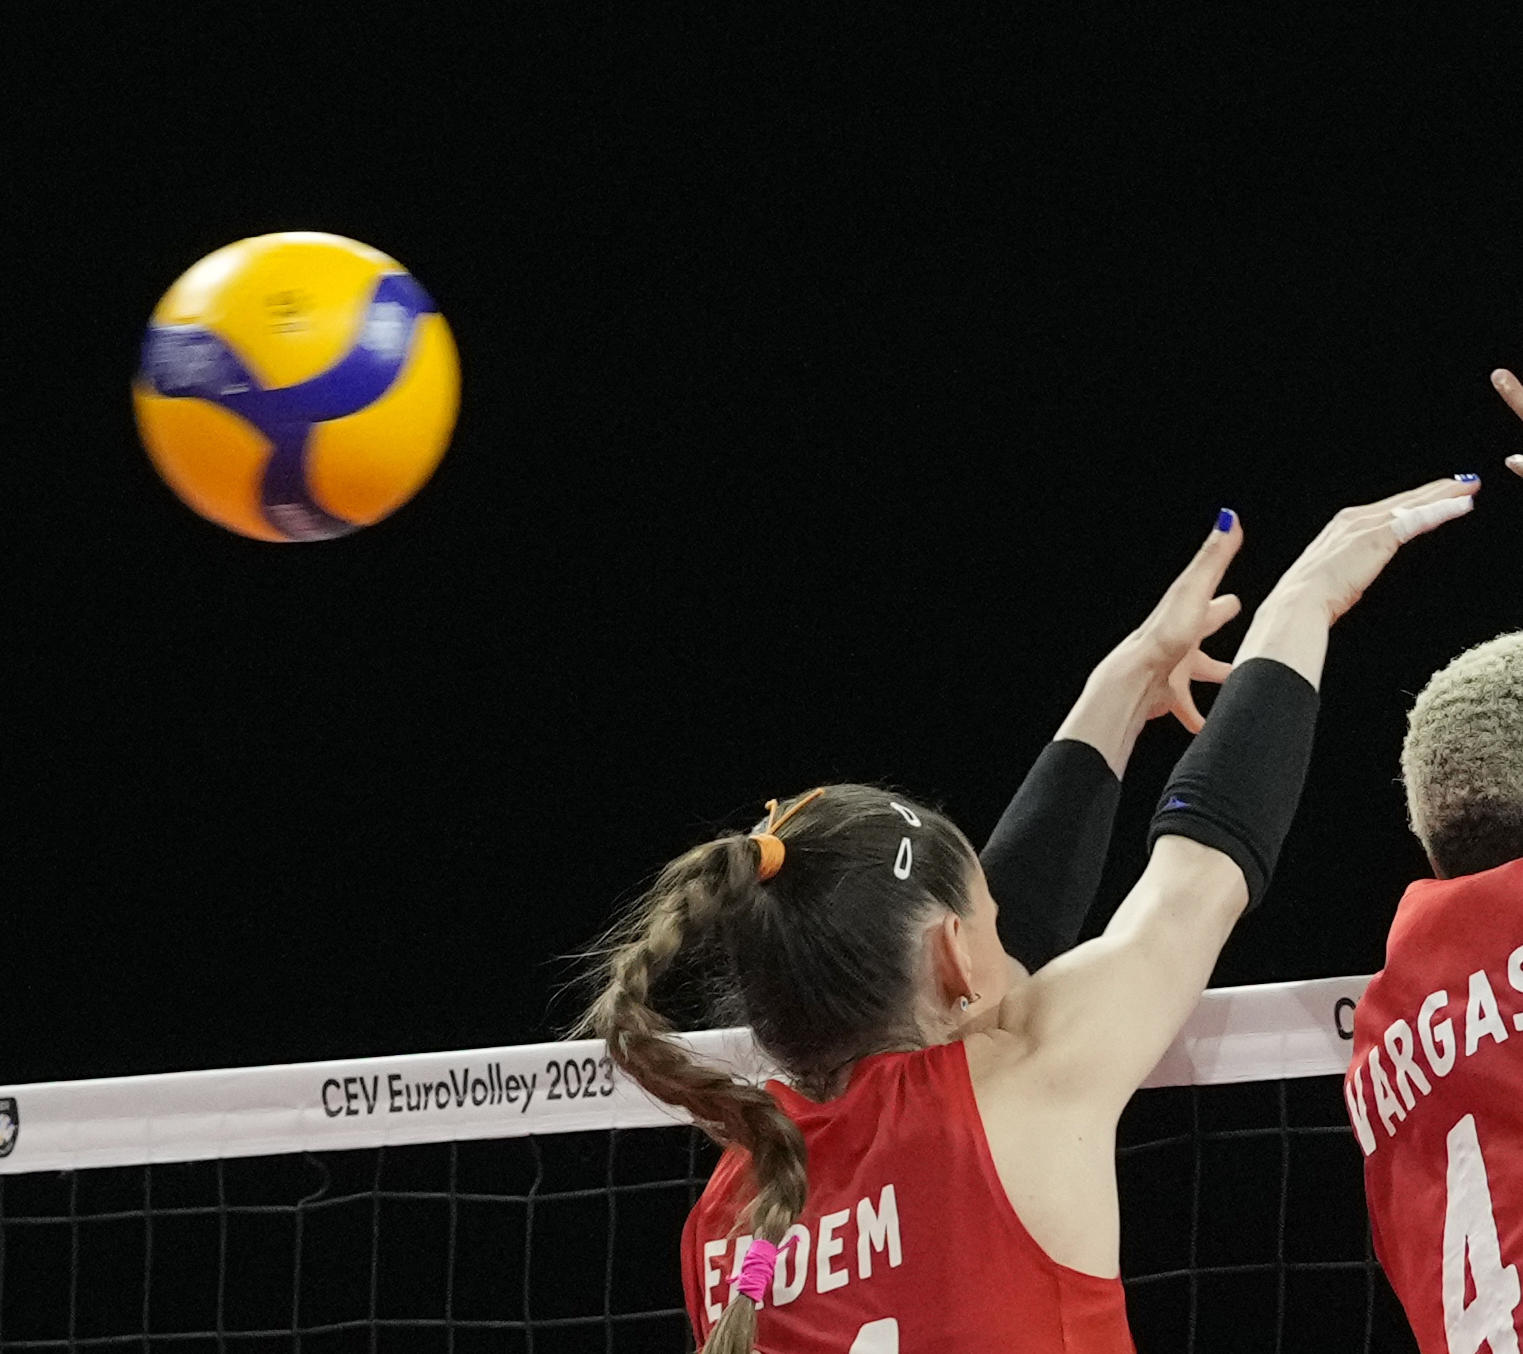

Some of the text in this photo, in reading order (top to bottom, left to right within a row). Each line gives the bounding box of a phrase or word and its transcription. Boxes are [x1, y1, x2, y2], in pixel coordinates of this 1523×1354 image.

[322, 1057, 616, 1117] CEV EuroVolley 2023
